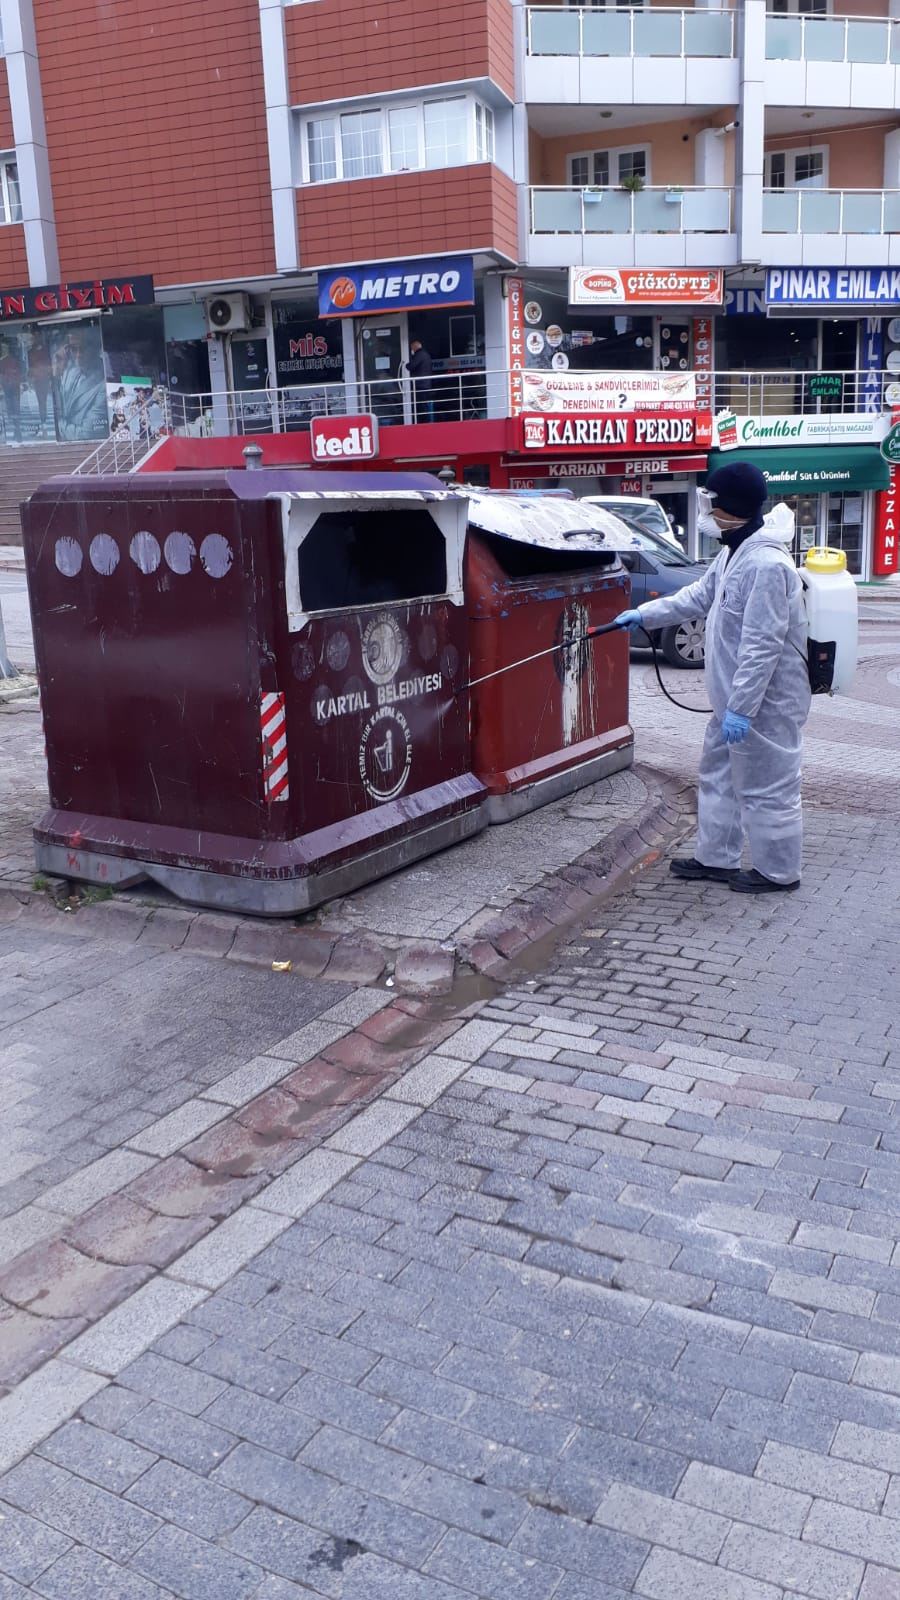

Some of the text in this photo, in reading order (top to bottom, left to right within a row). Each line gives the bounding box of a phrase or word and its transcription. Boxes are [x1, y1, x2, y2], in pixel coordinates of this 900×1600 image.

[360, 270, 461, 300] METRO
[627, 272, 711, 294] ÇİĞKÖFTE
[769, 270, 900, 299] PINAR EMLAK
[0, 280, 136, 316] N GİYİM
[695, 319, 711, 411] İĞKÖFT
[865, 317, 882, 413] MLAK
[546, 380, 585, 391] GÖZLEME
[594, 379, 660, 392] SANDVİÇLERİMİZİ
[810, 376, 842, 387] PINAR
[811, 387, 840, 396] EMLAK
[562, 398, 604, 410] DENEDİNİZ
[618, 393, 628, 409] ?
[315, 426, 372, 457] tedi
[526, 426, 545, 441] TAÇ
[547, 419, 629, 445] KARHAN
[635, 418, 694, 443] PERDE
[742, 419, 804, 442] Çamlıbel
[550, 460, 669, 477] KARHAN PERDE
[800, 472, 812, 481] Süt
[813, 472, 820, 480] &
[820, 471, 850, 480] Ürünleri
[884, 464, 896, 565] ECZANE
[316, 671, 442, 720] KARTAL BELEDİYESİ
